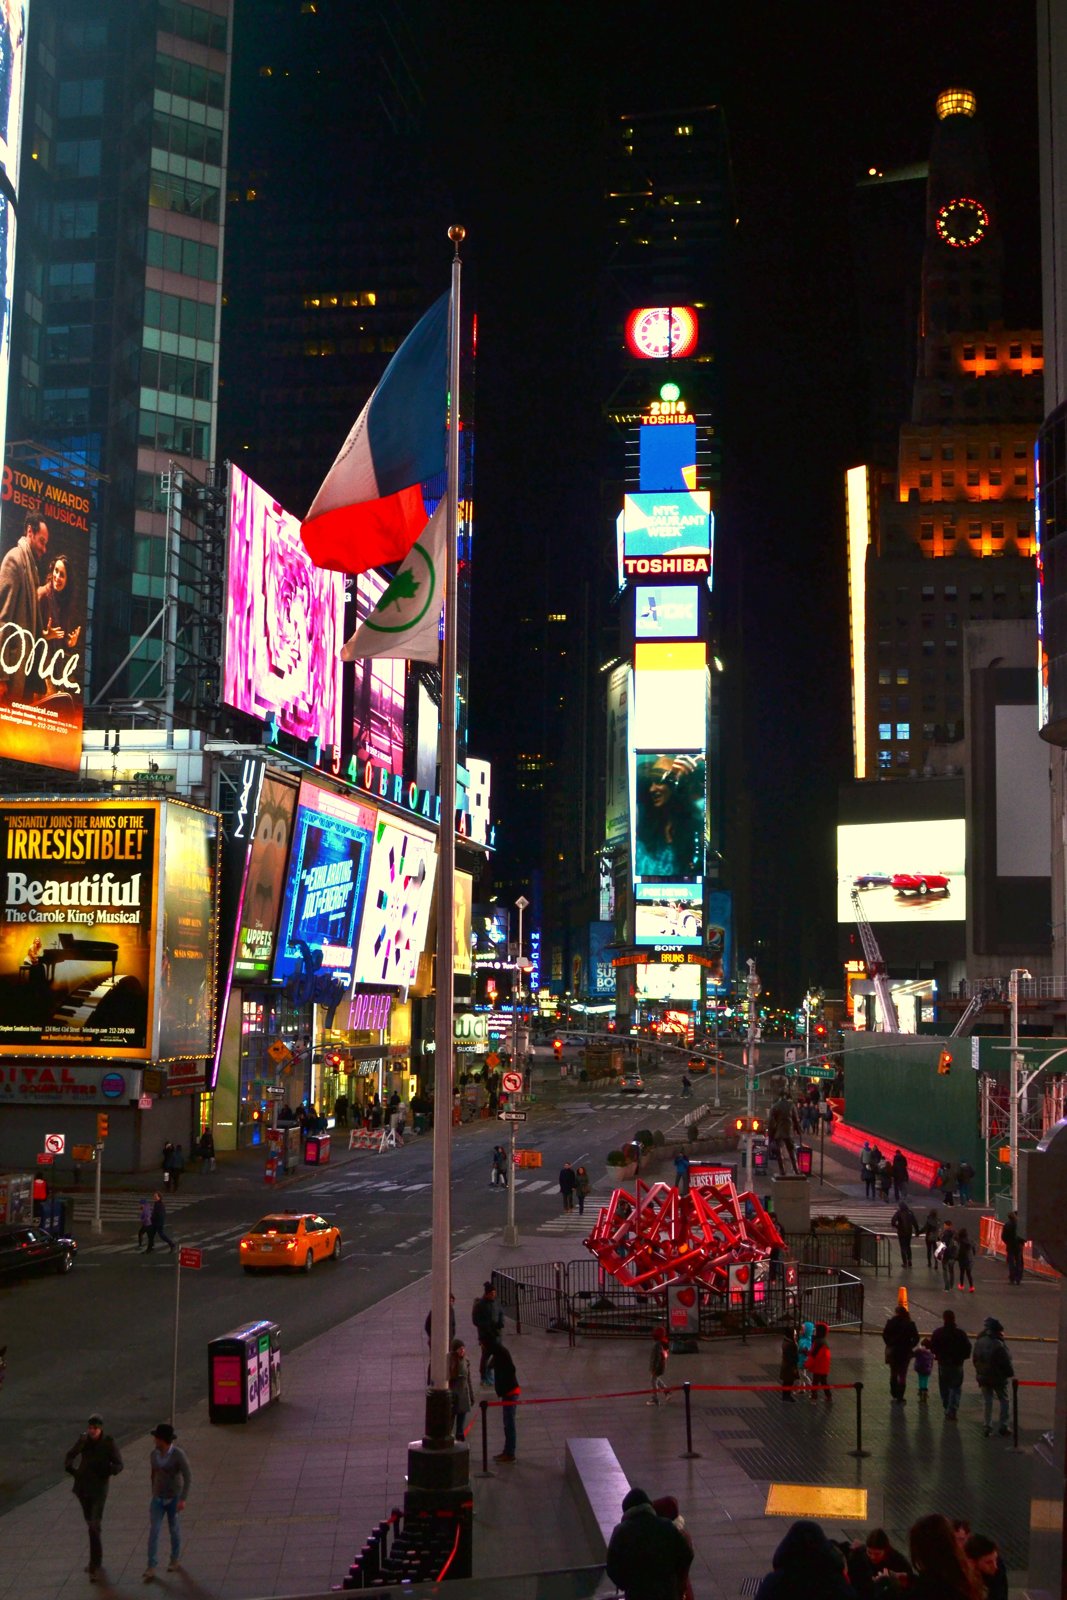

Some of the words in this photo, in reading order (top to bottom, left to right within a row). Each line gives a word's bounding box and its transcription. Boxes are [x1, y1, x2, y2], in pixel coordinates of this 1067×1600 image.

[650, 401, 687, 415] 2014
[642, 414, 695, 425] TOSHIBA
[13, 470, 43, 494] TONY
[45, 484, 89, 513] AWARDS
[13, 490, 42, 511] BEST
[44, 502, 89, 532] MUSICAL
[653, 505, 679, 516] NYC
[647, 526, 685, 537] WEEK
[625, 558, 709, 573] TOSHIBA
[11, 701, 59, 718] oncemusical.com
[315, 736, 373, 790] 1540
[138, 773, 172, 782] LAMAR
[379, 767, 475, 838] BROADA
[49, 815, 72, 828] JOINS
[73, 816, 87, 828] THE
[89, 816, 116, 828] RANKS
[117, 816, 129, 828] OF
[129, 816, 144, 828] THE
[5, 872, 142, 907] Beautiful
[5, 908, 26, 923] The
[28, 909, 66, 923] Carole
[67, 909, 94, 926] King
[96, 909, 140, 924] Musical
[661, 954, 684, 963] BRUINS
[347, 994, 391, 1030] FOREVER
[19, 1084, 97, 1094] COMPUTERS
[689, 1174, 713, 1187] JERSEY
[714, 1173, 732, 1185] BOYS
